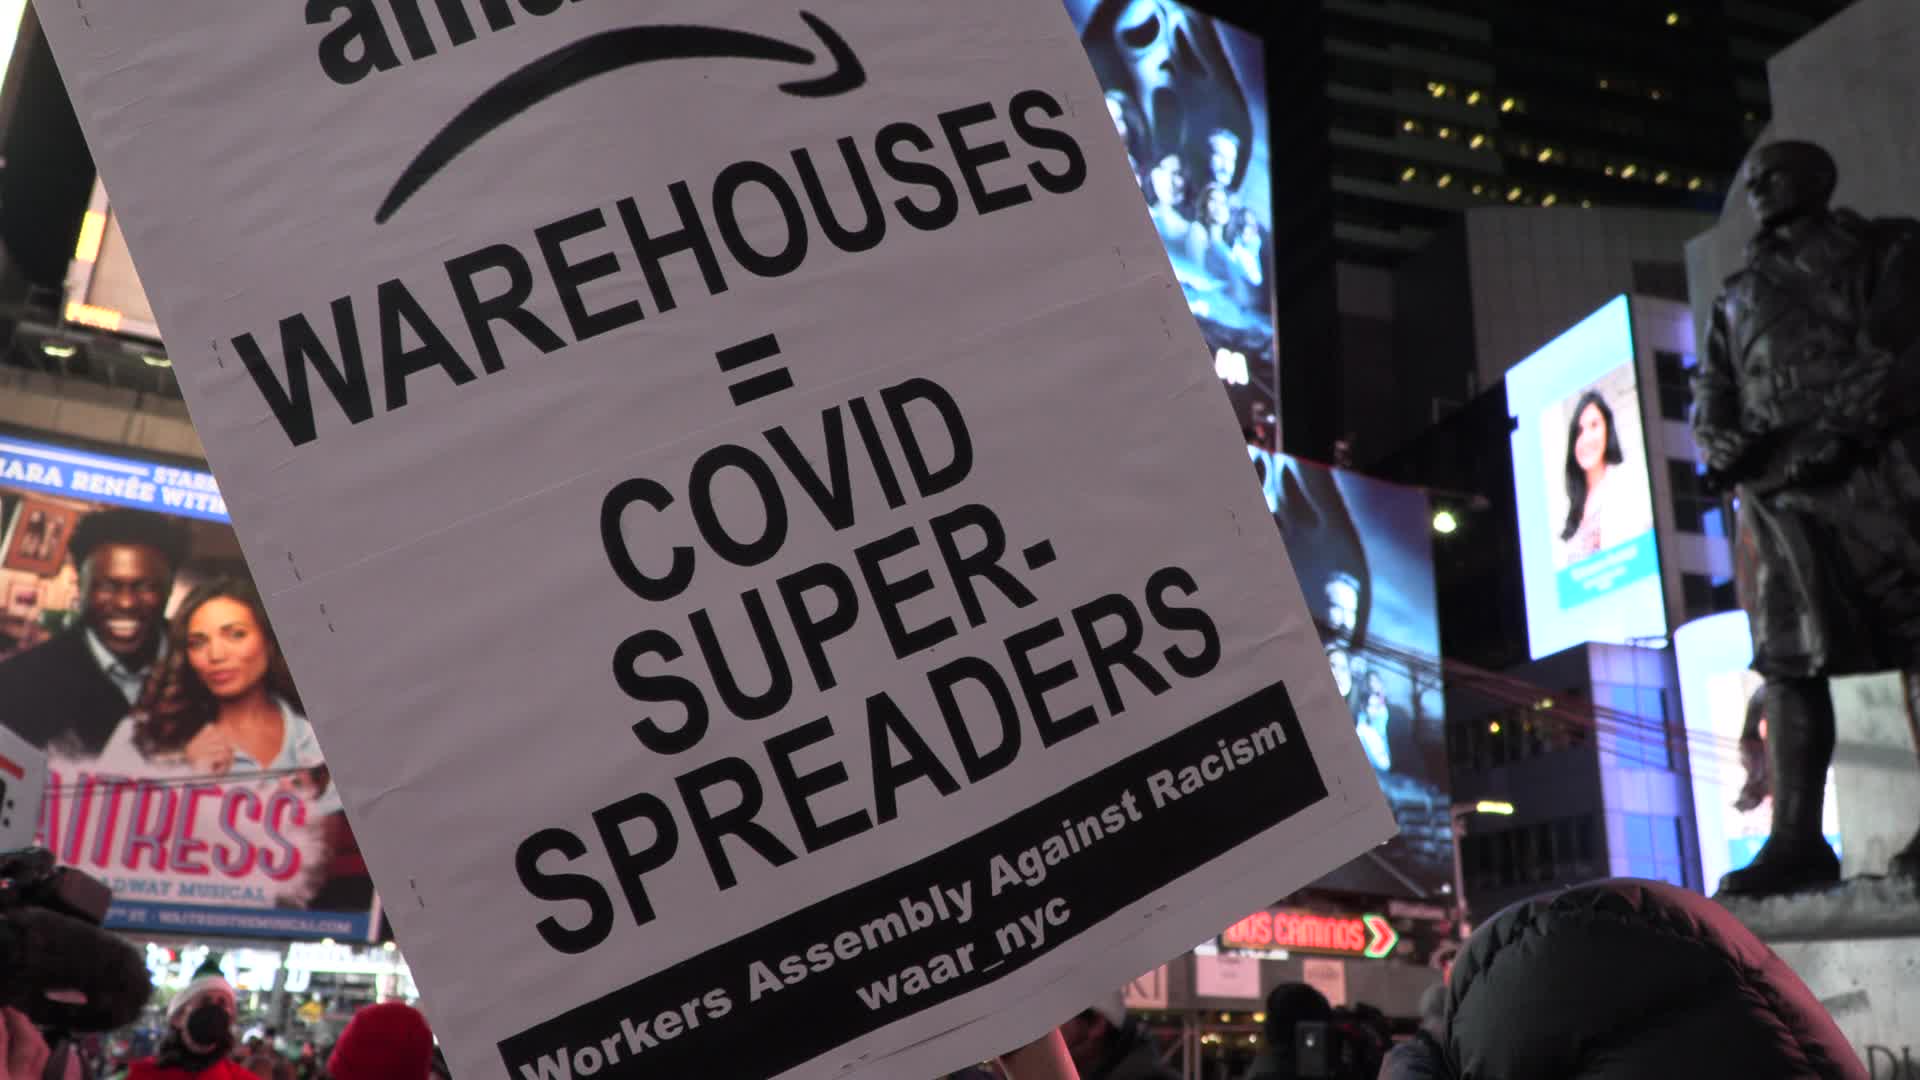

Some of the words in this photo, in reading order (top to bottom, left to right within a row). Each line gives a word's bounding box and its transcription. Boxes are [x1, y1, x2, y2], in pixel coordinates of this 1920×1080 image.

[231, 90, 1087, 447] WAREHOUSES
[715, 333, 794, 407] =
[600, 377, 974, 602] COVID
[612, 503, 1057, 756] SUPER-
[514, 566, 1222, 955] SPREADERS
[102, 876, 172, 897] DWAY
[519, 987, 732, 1080] Workers
[748, 880, 973, 1002] Assembly
[989, 788, 1142, 898] Against
[1144, 717, 1287, 809] Racism
[855, 896, 1073, 1010] waar_nyc
[1274, 913, 1365, 950] CAMINOS
